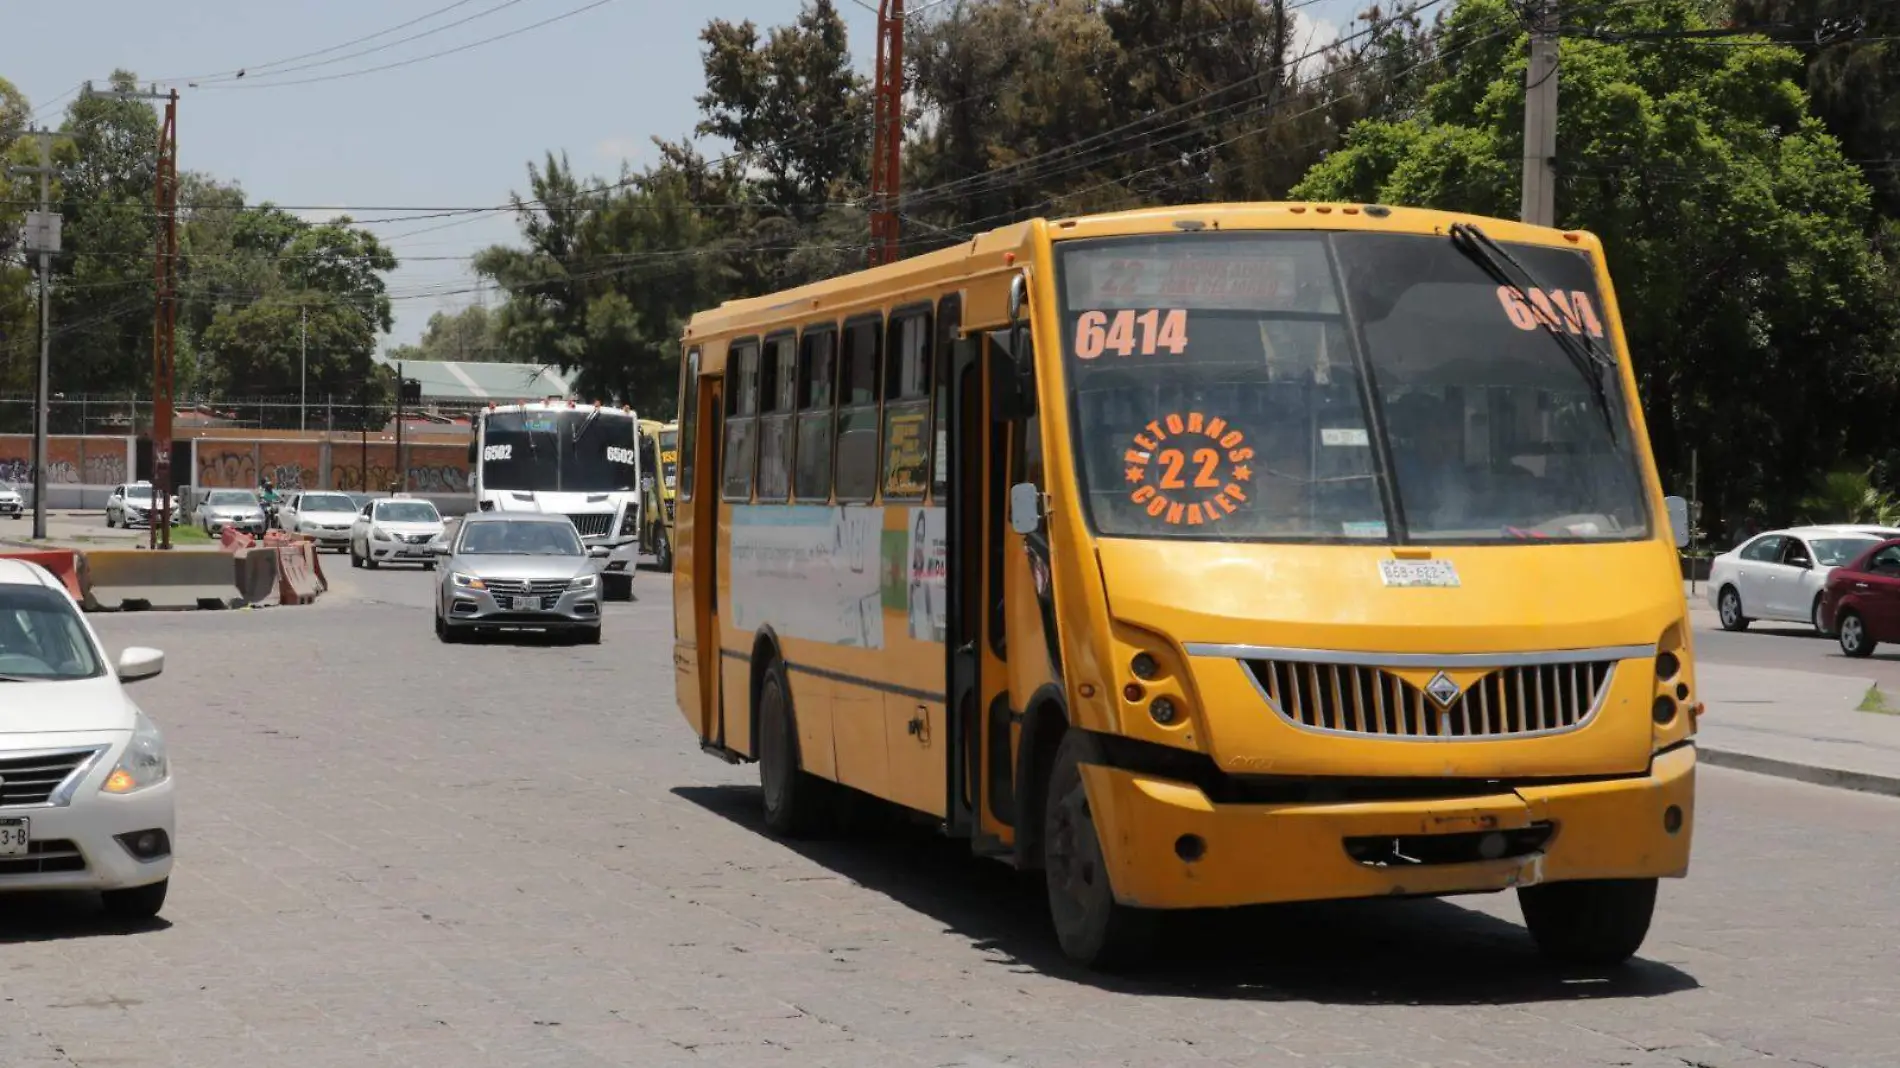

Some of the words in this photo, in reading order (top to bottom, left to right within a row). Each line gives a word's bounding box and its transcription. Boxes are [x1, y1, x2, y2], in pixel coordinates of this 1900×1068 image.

[1100, 259, 1146, 297] 22
[1075, 309, 1188, 359] 6414
[484, 444, 512, 461] 6502
[607, 446, 635, 464] 6502
[1125, 412, 1253, 465] RETORNOS
[1158, 448, 1221, 489] 22
[1131, 484, 1247, 525] CONALEP
